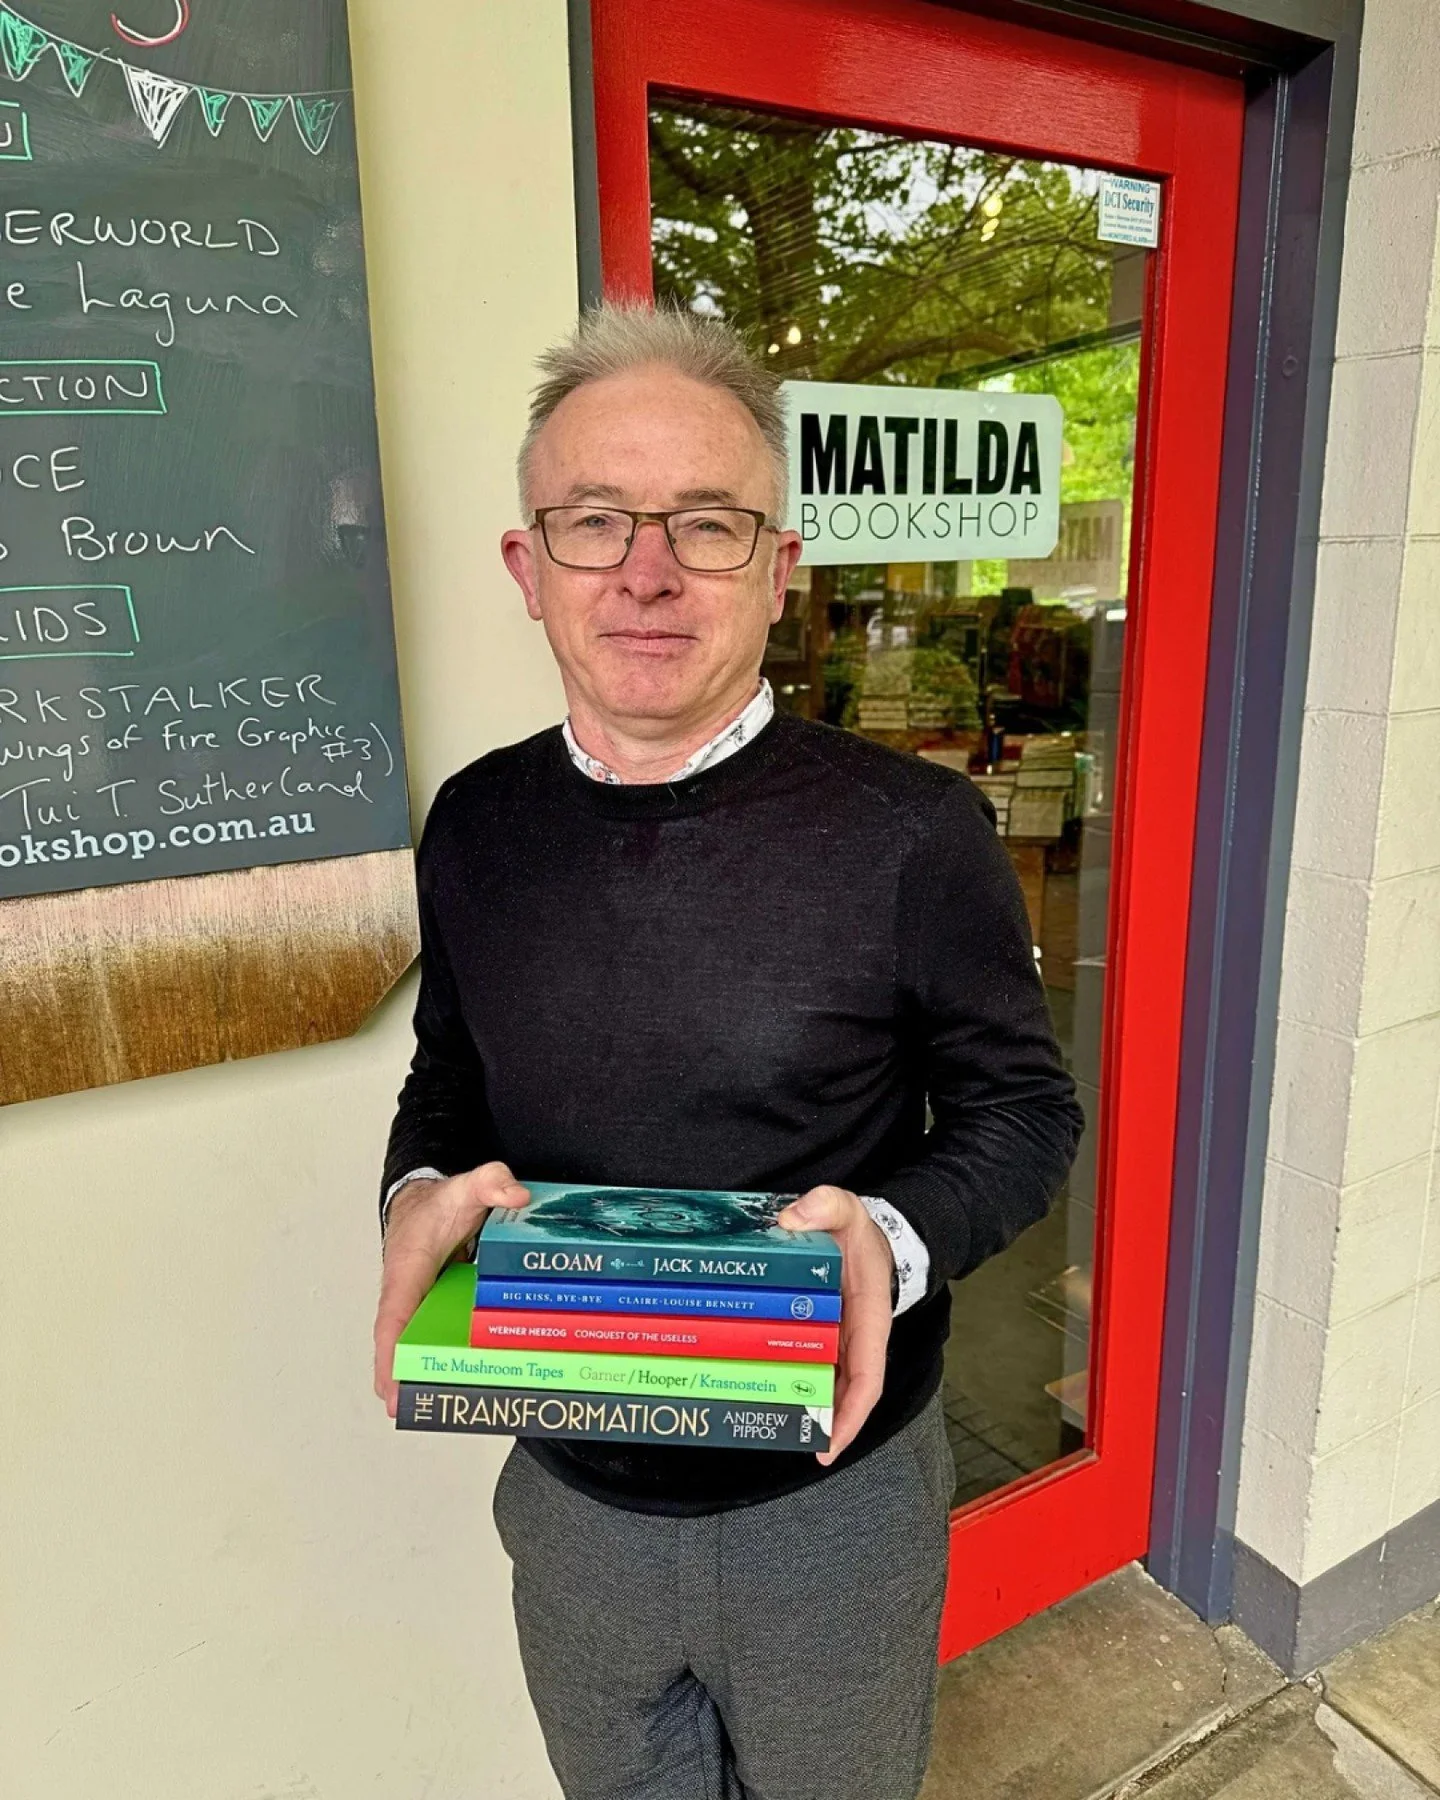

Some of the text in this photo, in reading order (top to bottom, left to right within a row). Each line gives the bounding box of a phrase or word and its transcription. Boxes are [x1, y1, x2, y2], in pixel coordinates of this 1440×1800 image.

[1111, 178, 1151, 194] WARNING
[1122, 193, 1156, 218] Security
[0, 210, 280, 256] ERWORLD
[77, 261, 298, 346] Laguna
[0, 446, 86, 492] CE
[800, 413, 1042, 495] MATILDA
[62, 516, 255, 562] Brown
[801, 501, 1039, 541] BOOKSHOP
[0, 602, 107, 643] IDS
[106, 724, 143, 750] of
[162, 720, 220, 751] Fire
[238, 717, 347, 754] Graphic
[158, 766, 374, 815] Sutherland
[523, 1251, 768, 1277] GLOAM JACK MACKAY
[503, 1292, 522, 1301] BIG
[525, 1292, 553, 1302] KISS,
[556, 1294, 602, 1304] BYE-BYE
[706, 1299, 755, 1310] BENNETT
[488, 1325, 697, 1344] WERNER HERZOG CONQUEST OF THE USELESS
[767, 1339, 824, 1350] VINTAGE CLASSICS
[421, 1356, 448, 1372] The
[451, 1358, 523, 1377] Mushroom
[526, 1362, 564, 1380] Tapes
[579, 1365, 626, 1383] Garner
[638, 1370, 689, 1389] Hooper
[700, 1374, 777, 1393] Krasnostein
[414, 1392, 710, 1437] THE TRANSFORMATIONS
[723, 1411, 788, 1428] ANDREW
[732, 1425, 777, 1440] PIPPOS
